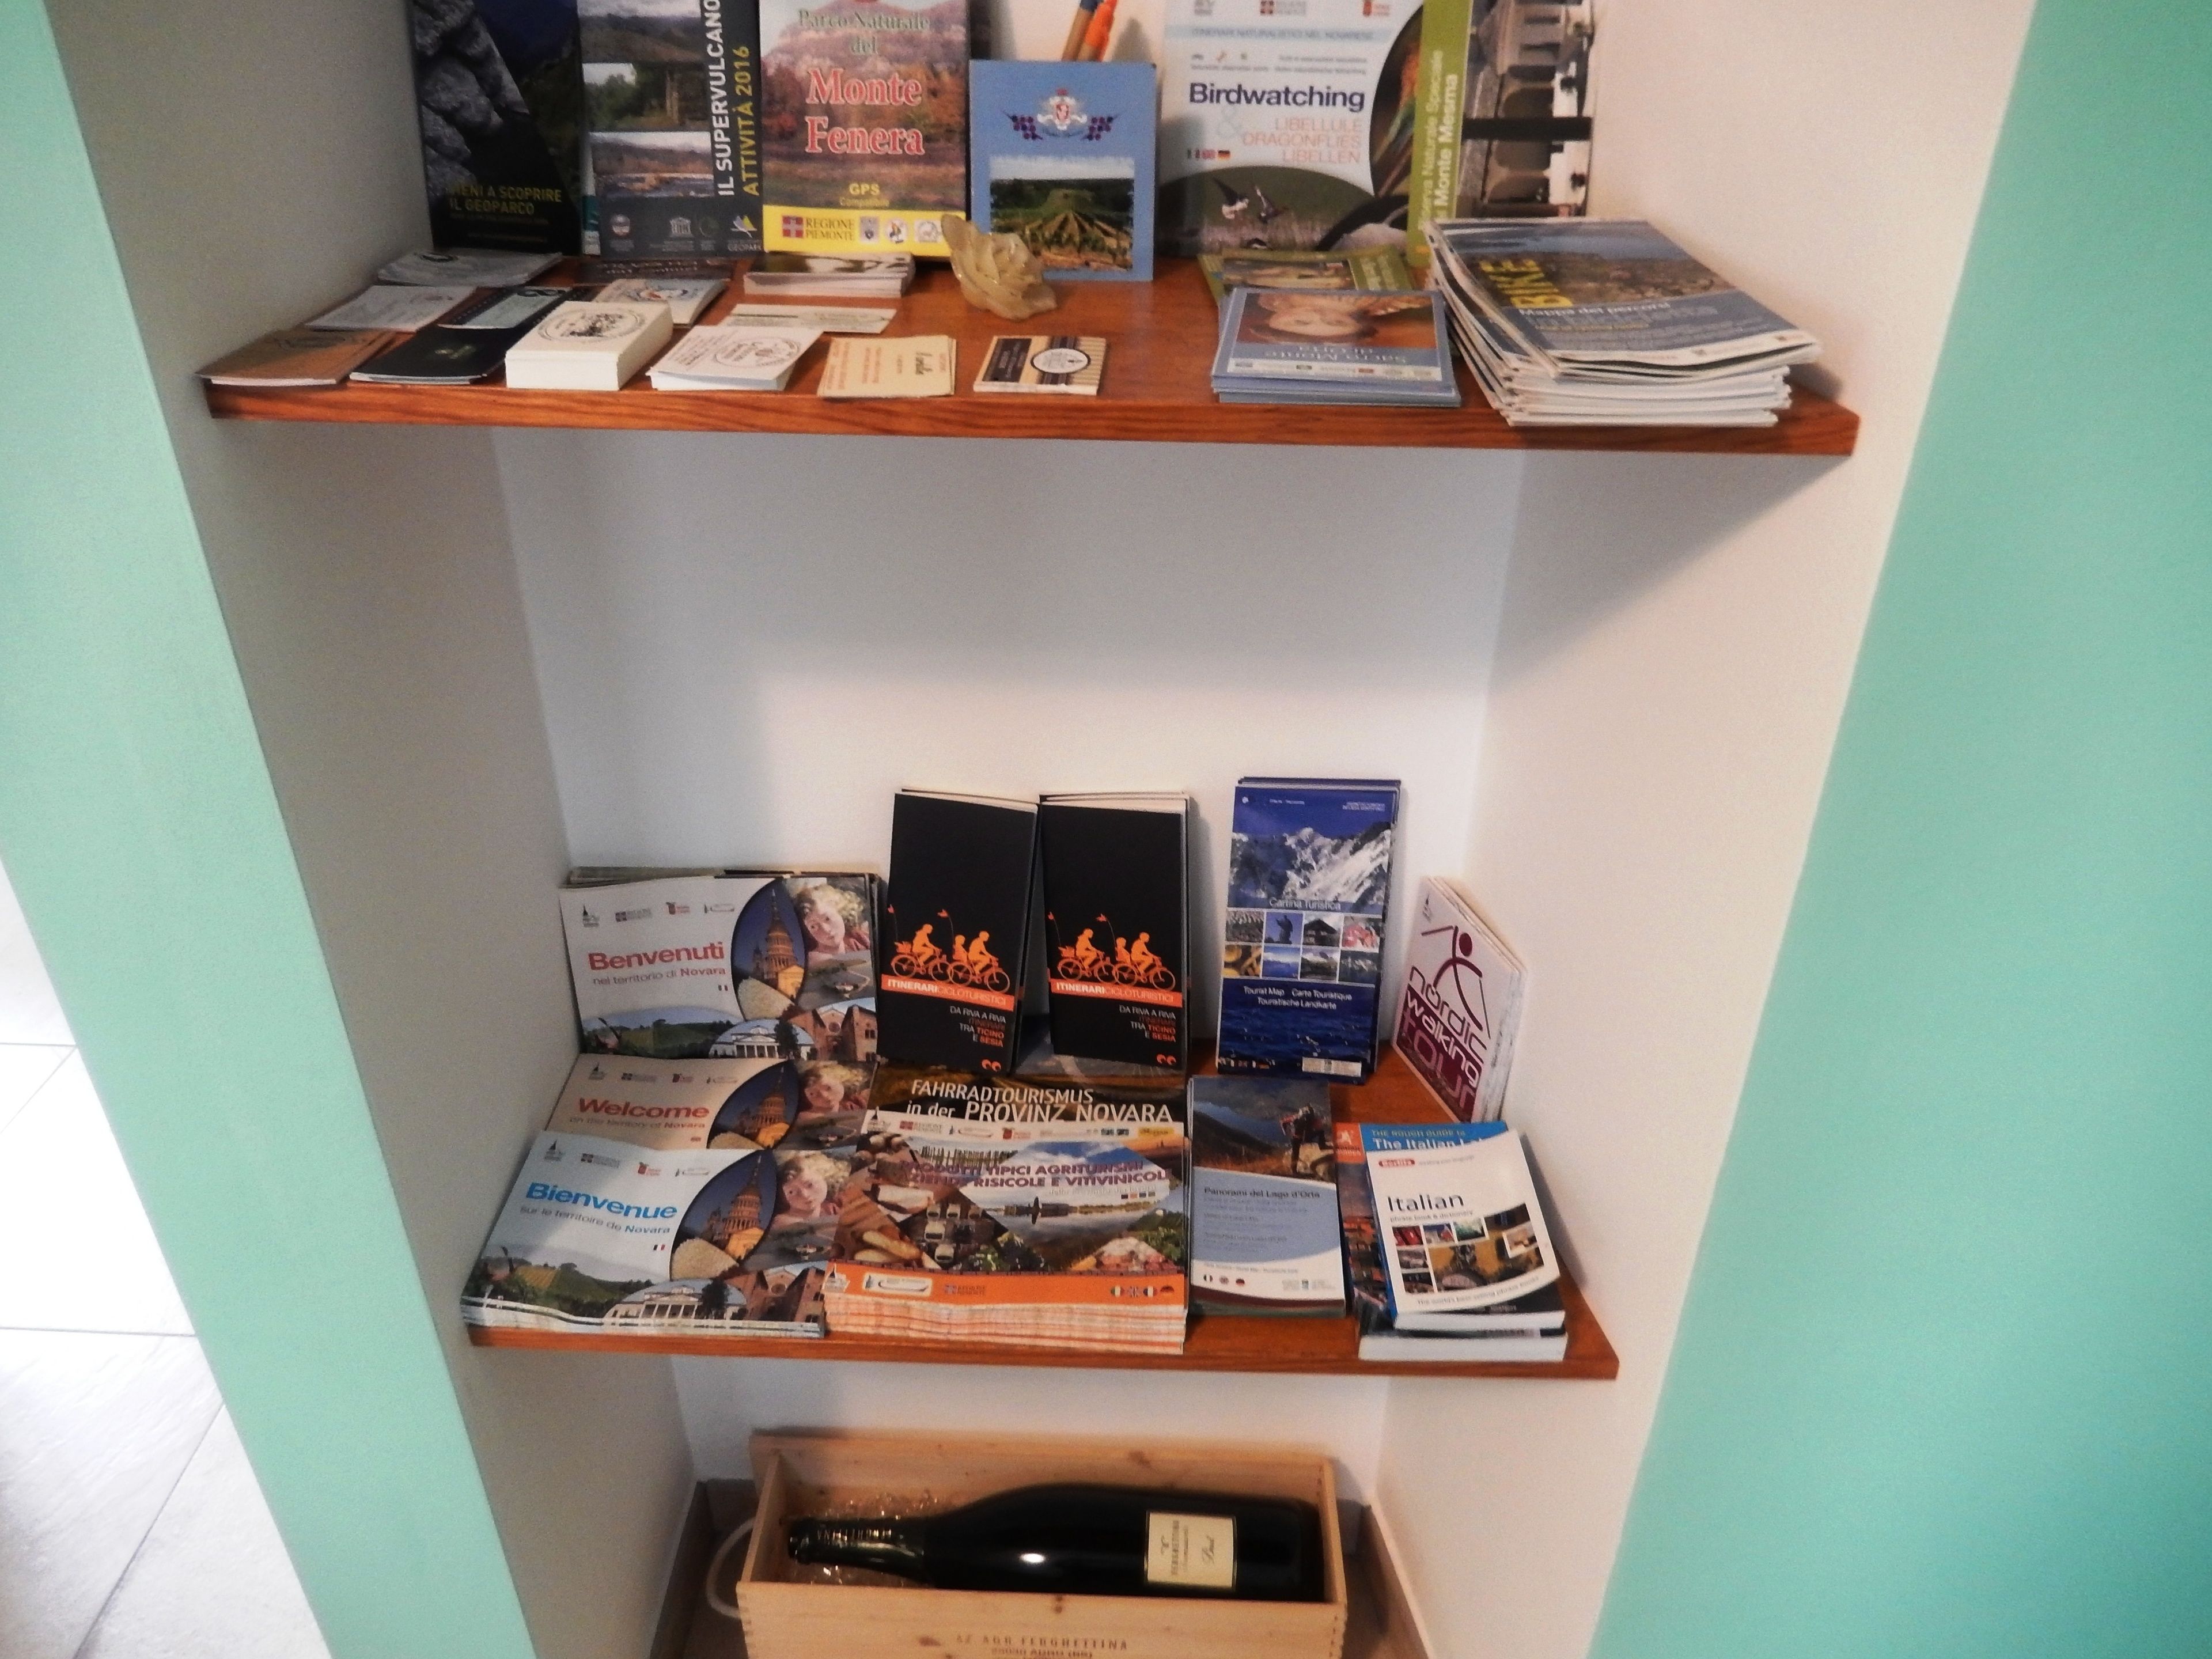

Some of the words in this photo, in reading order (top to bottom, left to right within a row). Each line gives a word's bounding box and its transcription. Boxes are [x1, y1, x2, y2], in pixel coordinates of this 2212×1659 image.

[798, 10, 848, 29] Parco
[855, 11, 930, 30] Naturale
[850, 36, 878, 56] del
[733, 46, 751, 97] 2016
[702, 0, 733, 172] SUPERVULCANO
[806, 67, 922, 106] Monte
[1189, 82, 1365, 113] Birdwatching
[1438, 74, 1458, 143] Mesma
[1275, 118, 1363, 131] LIBELLULE
[805, 115, 925, 156] Fenera
[1243, 131, 1362, 148] DRAGONFLIES
[1421, 116, 1438, 175] Naturale
[1282, 149, 1361, 163] LIBELLEN
[716, 175, 735, 196] IL
[1434, 148, 1452, 206] Monte
[487, 185, 496, 198] A
[498, 185, 562, 203] SCOPRIRE
[849, 183, 880, 195] GPS
[450, 198, 462, 211] IL
[464, 199, 535, 215] GEOPARCO
[806, 217, 854, 230] REGIONE
[806, 229, 853, 241] PIEMONTE
[1269, 897, 1302, 908] Cartina
[1305, 899, 1341, 910] Turistica
[588, 941, 725, 971] Benvenuti
[593, 976, 611, 986] nel
[613, 971, 664, 985] territorio
[665, 968, 677, 980] di
[680, 967, 726, 978] Novara
[1244, 986, 1267, 995] Tourist
[1268, 987, 1285, 997] Map
[1292, 988, 1313, 998] Carte
[1313, 989, 1352, 1001] Touristique
[1119, 1004, 1131, 1013] DA
[1132, 1006, 1150, 1016] RIVA
[1158, 1010, 1176, 1020] RIVA
[1257, 997, 1300, 1007] Touristische
[1300, 999, 1337, 1010] Landkarte
[950, 1005, 961, 1016] DA
[963, 1007, 980, 1019] RIVA
[981, 1012, 988, 1020] A
[989, 1012, 1006, 1024] RIVA
[1410, 965, 1487, 1065] nordic
[959, 1023, 975, 1033] TRA
[977, 1027, 1005, 1039] TICINO
[1130, 1020, 1146, 1031] TRA
[1147, 1024, 1176, 1035] TICINO
[972, 1033, 979, 1043] E
[980, 1036, 1004, 1048] SESIA
[1145, 1031, 1150, 1039] E
[1152, 1033, 1176, 1043] SESIA
[1407, 989, 1479, 1089] walking
[911, 1079, 1095, 1104] FAHRRADTOURISMUS
[577, 1097, 710, 1120] Welcome
[906, 1100, 921, 1116] in
[927, 1101, 956, 1119] der
[964, 1101, 1064, 1123] PROVINZ
[1075, 1103, 1174, 1123] NOVARA
[1373, 1137, 1402, 1150] The
[1406, 1138, 1456, 1150] Italian
[987, 1164, 1031, 1176] TIPICI
[1035, 1160, 1144, 1175] AGRITURISMI
[974, 1176, 1046, 1188] RISICOLE
[1051, 1176, 1060, 1187] E
[525, 1181, 678, 1220] Bienvenue
[1204, 1187, 1247, 1197] Panorami
[1249, 1189, 1264, 1198] del
[1266, 1190, 1289, 1199] Lago
[1291, 1191, 1320, 1199] d'Orta
[1388, 1194, 1464, 1212] Italian
[555, 1209, 604, 1226] territoire
[606, 1220, 622, 1232] de
[624, 1225, 671, 1234] Novara
[1021, 1636, 1128, 1651] FERGHETTINA
